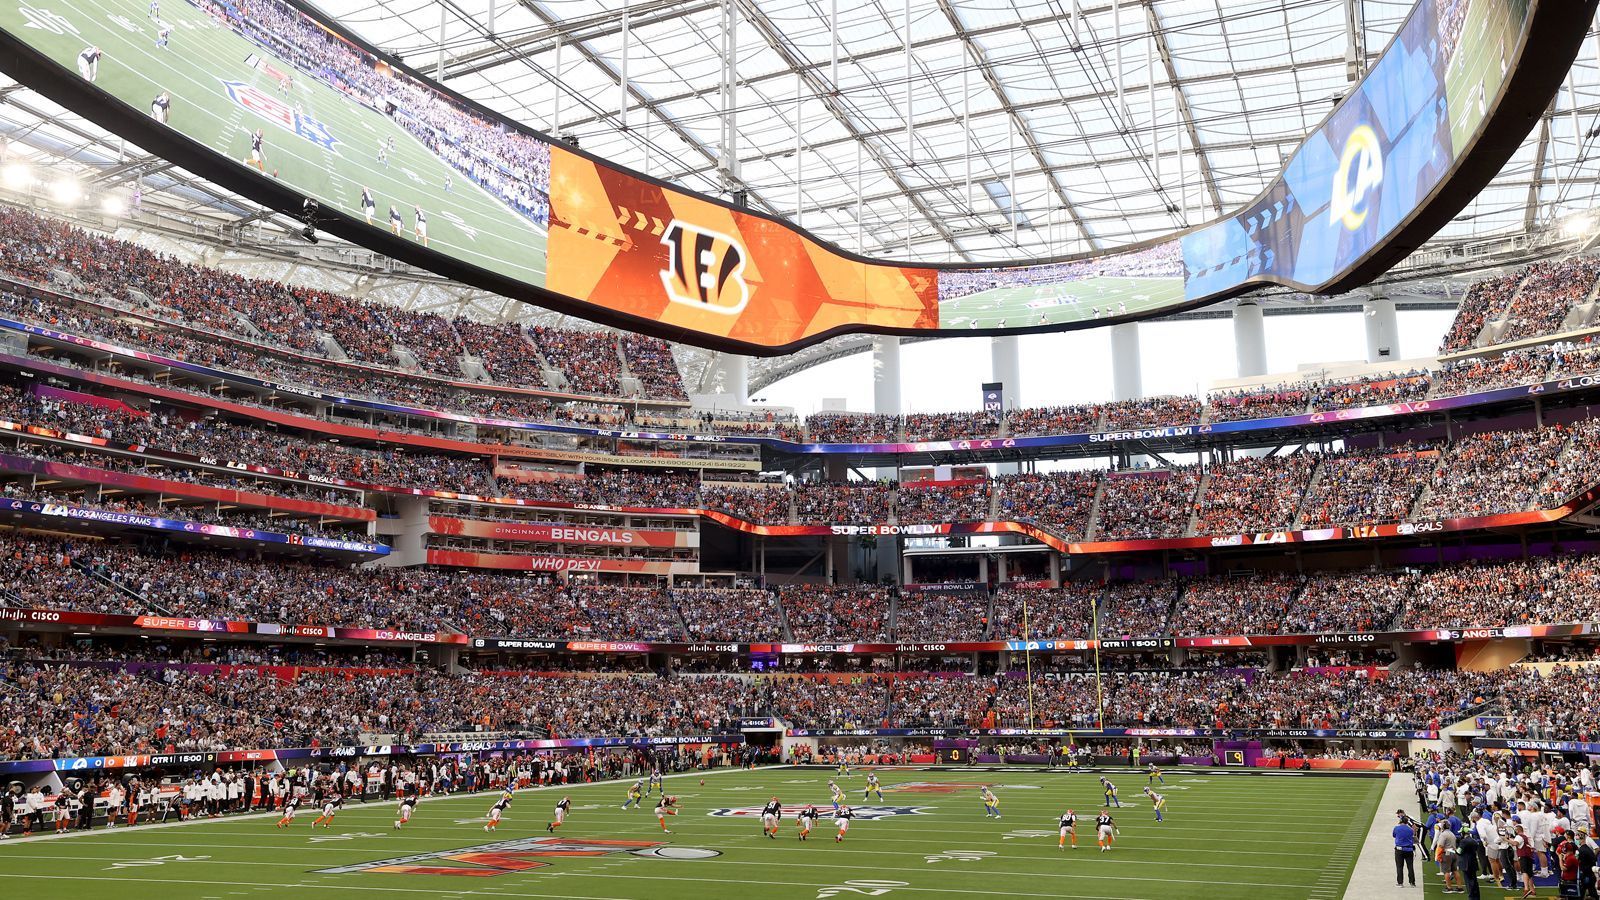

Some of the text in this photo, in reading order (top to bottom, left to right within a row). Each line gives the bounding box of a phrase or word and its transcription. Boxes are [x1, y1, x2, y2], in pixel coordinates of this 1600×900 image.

[1089, 427, 1193, 442] SUPER BOWL LVI
[200, 456, 217, 466] RAMS
[308, 474, 334, 484] BENGALS
[74, 509, 152, 526] LOS ANGELES RAMS
[832, 524, 942, 535] SUPER BOWL LVI
[1396, 522, 1443, 534] BENGALS
[495, 528, 633, 544] CINCINNATI BENGALS
[1211, 537, 1238, 546] RAMS
[532, 558, 564, 570] WHO
[31, 611, 60, 621] CISCO
[143, 618, 223, 631] SUPER BOWL
[376, 631, 436, 642] LOS ANGELES
[1348, 634, 1374, 642] CISCO
[1462, 629, 1518, 639] ANGELES
[572, 642, 639, 651] SUPER BOWL
[462, 742, 491, 751] BENGALS
[1507, 740, 1530, 749] SUPER
[1531, 742, 1551, 750] BOWL
[336, 746, 356, 756] RAMS
[179, 754, 202, 762] 15:00
[1234, 752, 1242, 762] 9
